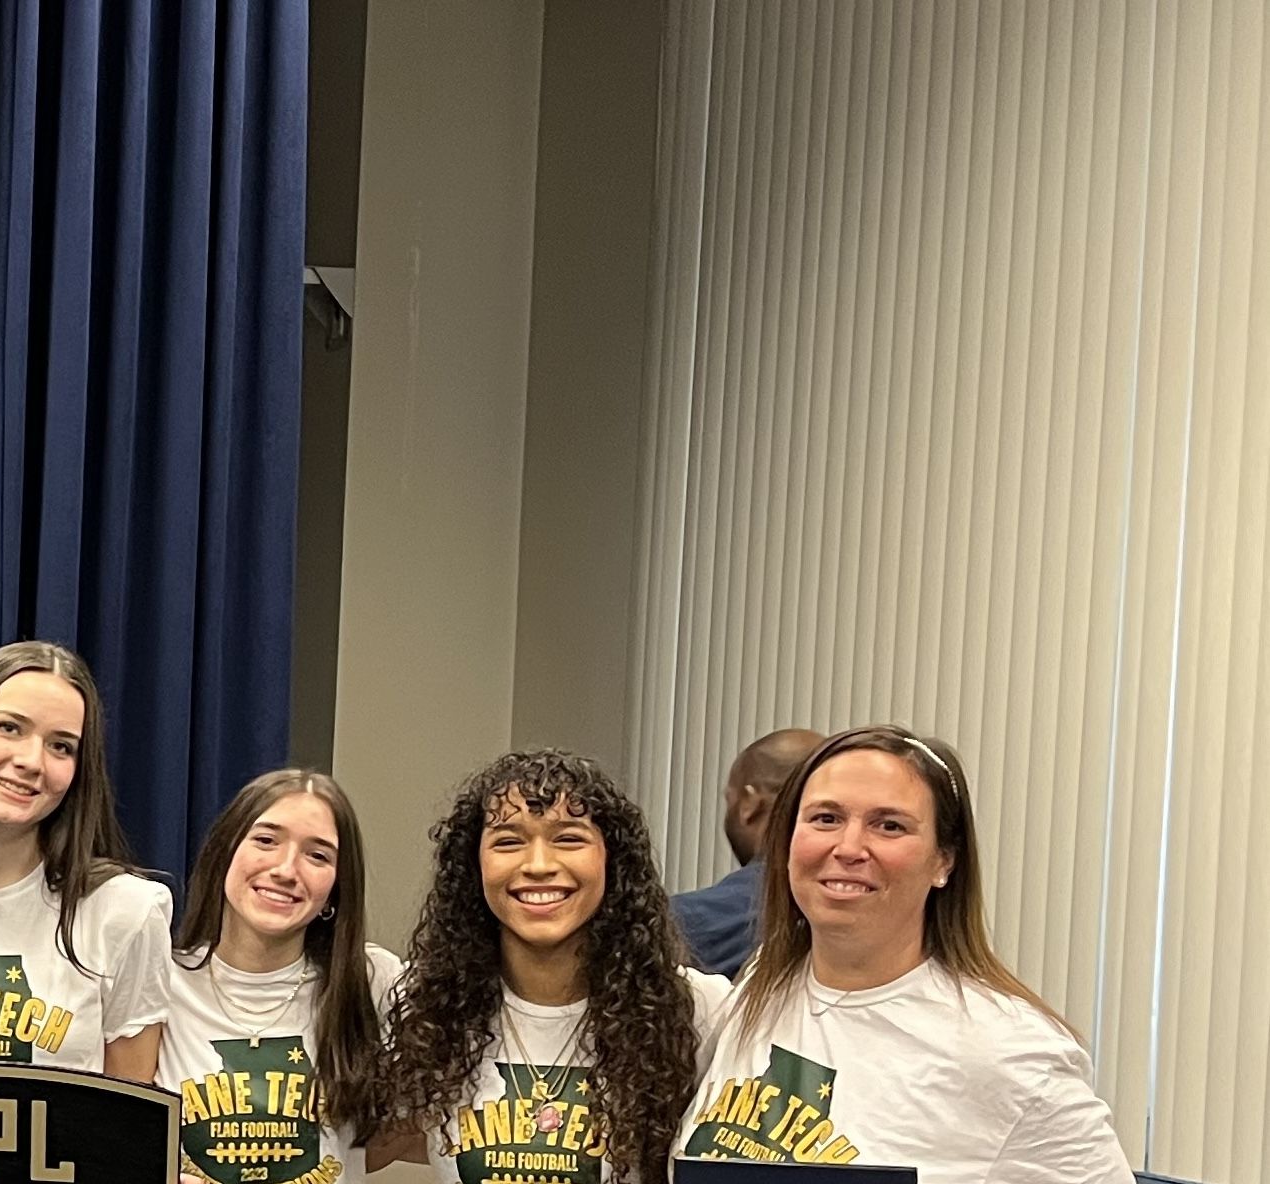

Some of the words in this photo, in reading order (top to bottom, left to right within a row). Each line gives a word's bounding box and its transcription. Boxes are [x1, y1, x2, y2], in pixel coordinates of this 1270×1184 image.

[182, 1072, 253, 1126] ANE
[693, 1078, 781, 1131] LANE
[211, 1121, 240, 1138] FLAG
[242, 1122, 299, 1138] FOOTBALL
[449, 1099, 534, 1156] ANE
[713, 1126, 741, 1151] FLAG
[485, 1150, 516, 1168] FLAG
[518, 1152, 579, 1171] FOOTBALL
